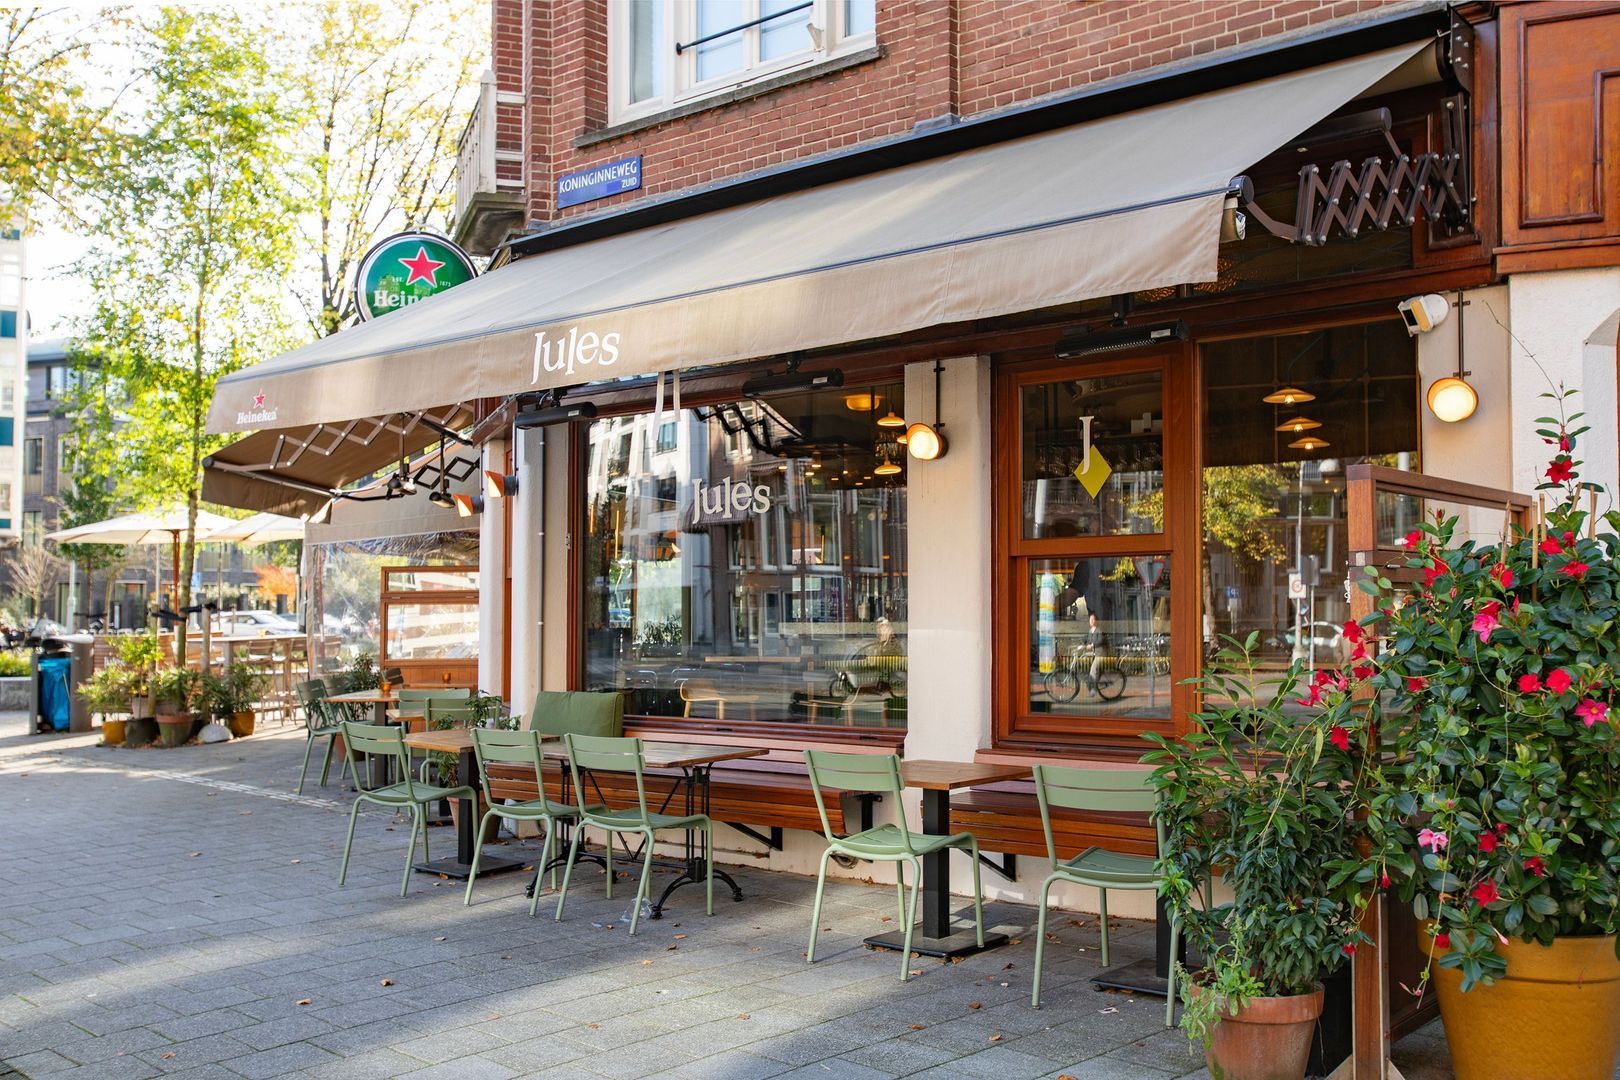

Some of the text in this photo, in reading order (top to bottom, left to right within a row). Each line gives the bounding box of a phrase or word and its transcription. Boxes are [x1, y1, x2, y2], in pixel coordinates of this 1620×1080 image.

[560, 161, 637, 193] KONINGINNEWEG
[622, 177, 637, 188] ZUID
[373, 290, 429, 307] Hein
[531, 326, 620, 384] Jules
[236, 410, 277, 424] Heineken
[1079, 415, 1095, 475] J
[692, 476, 771, 524] Jules
